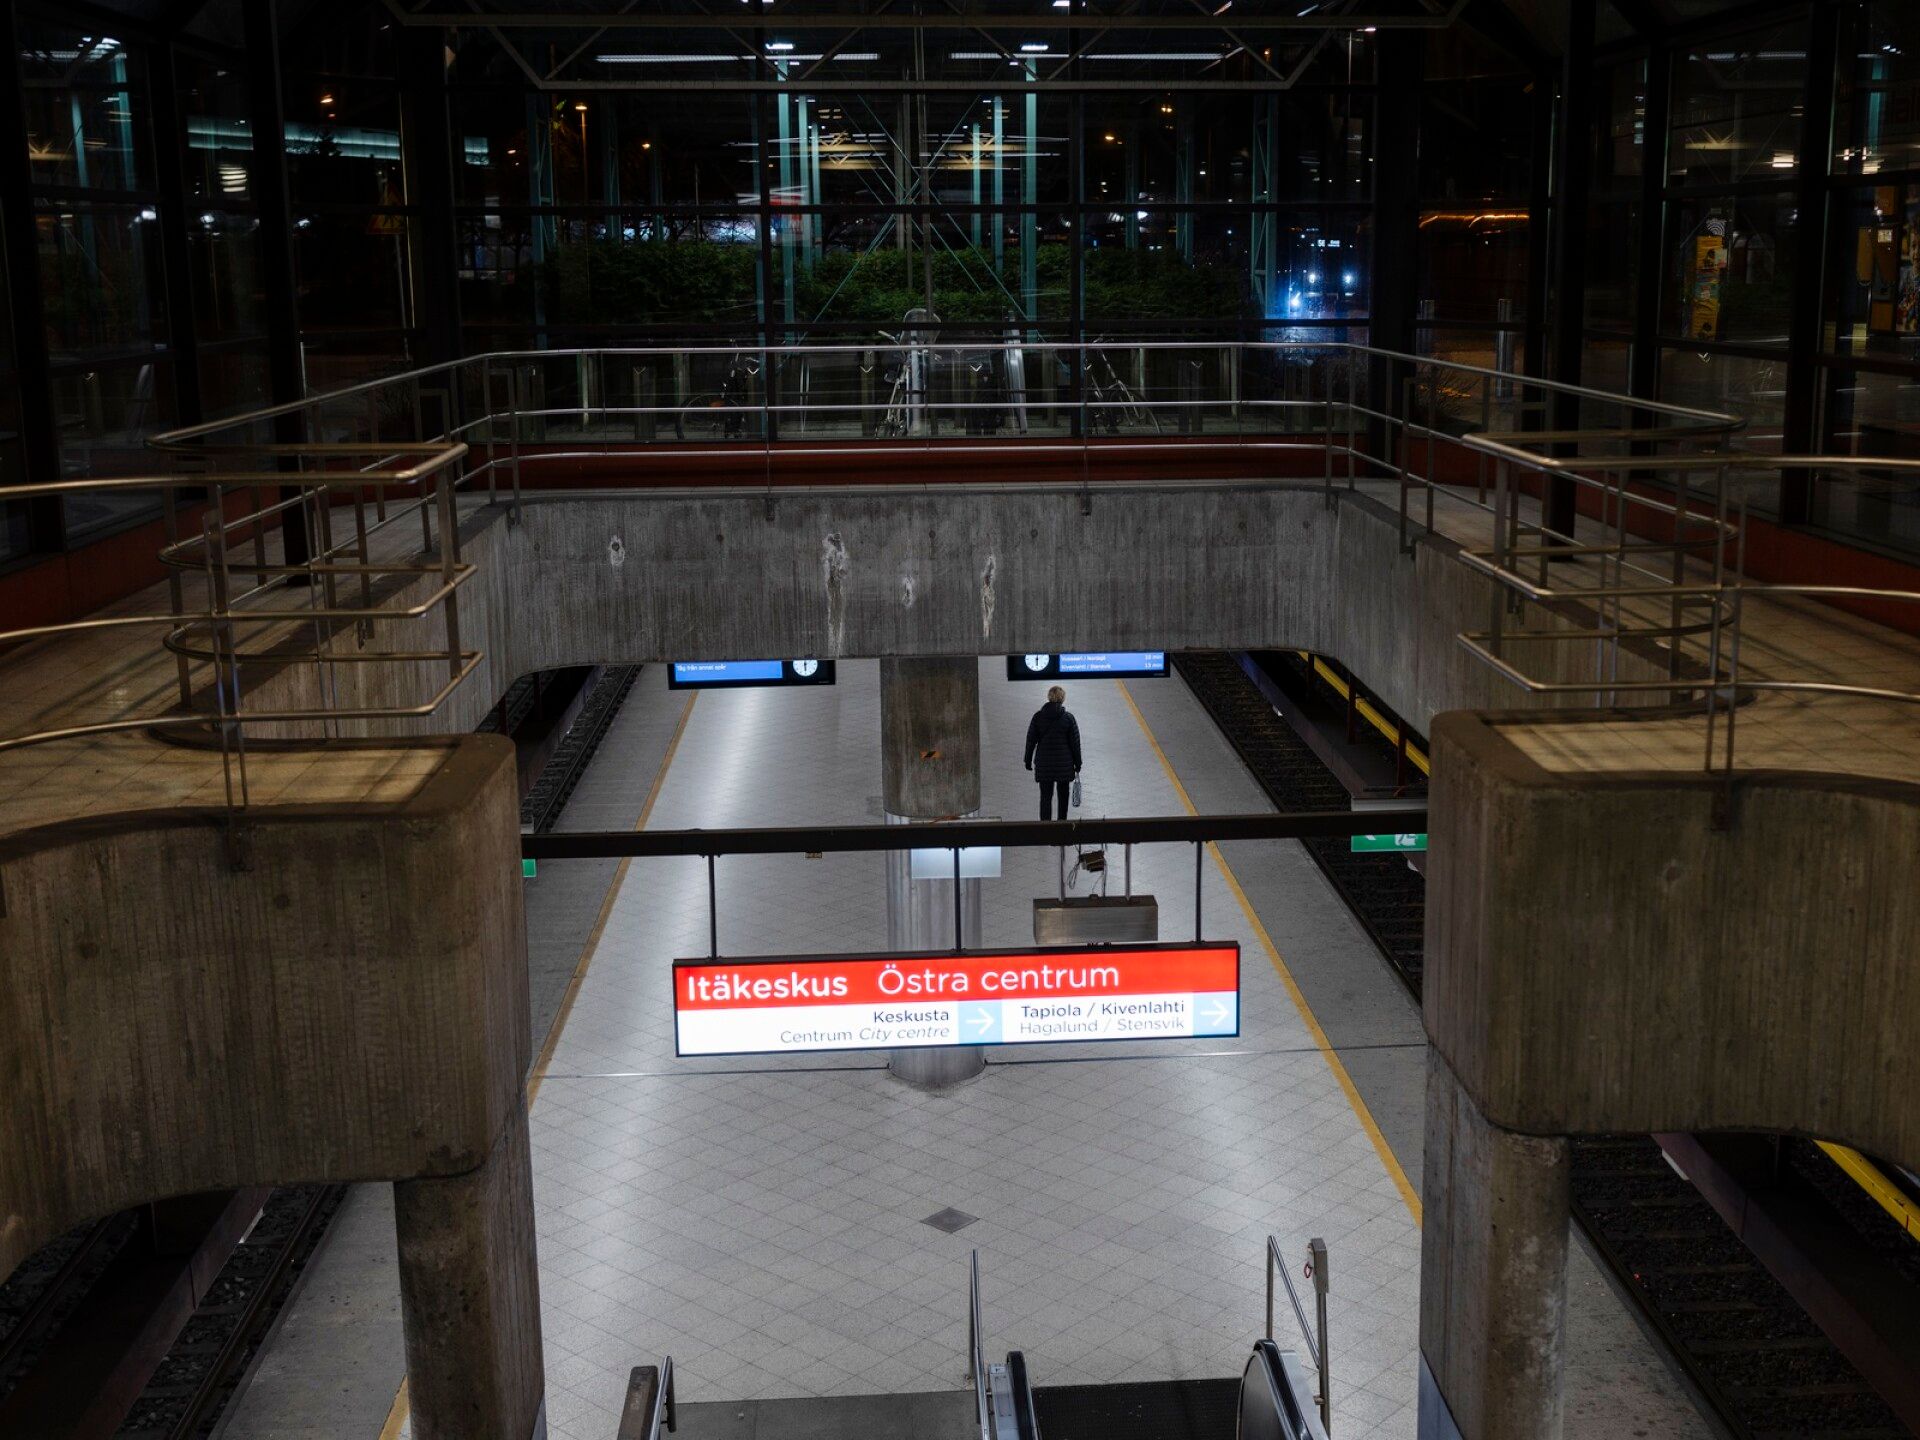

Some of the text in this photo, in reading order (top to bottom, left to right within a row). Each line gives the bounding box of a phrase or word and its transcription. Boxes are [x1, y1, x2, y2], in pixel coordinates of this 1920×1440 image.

[688, 964, 1120, 1001] Itäkeskus Östra centrum
[873, 1009, 949, 1023] Keskusta
[1021, 1000, 1184, 1020] Tapiola / Kivenlahti
[780, 1026, 950, 1043] Centrum City centre
[1020, 1017, 1184, 1036] Hagalund / Stensvik
